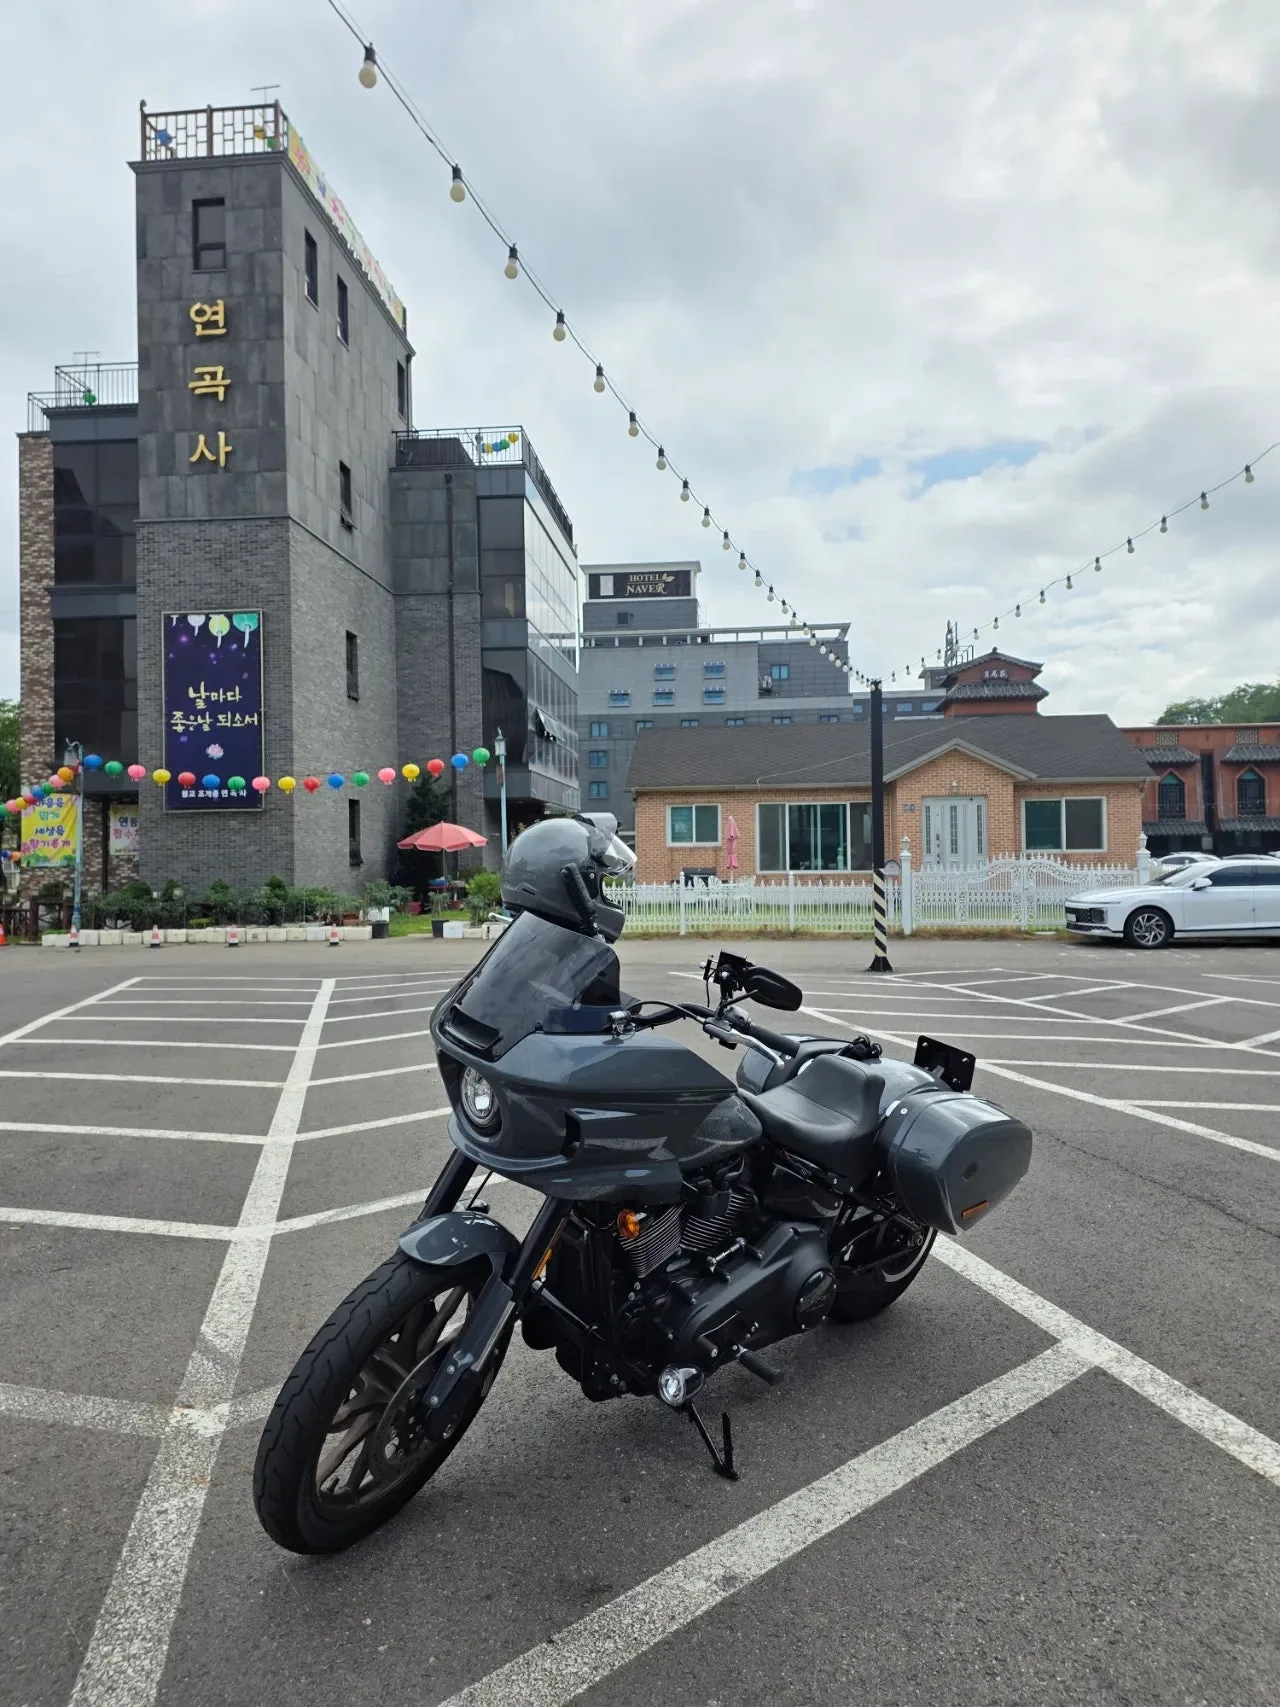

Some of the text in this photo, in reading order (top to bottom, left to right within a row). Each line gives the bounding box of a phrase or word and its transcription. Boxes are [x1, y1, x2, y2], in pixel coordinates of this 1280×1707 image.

[189, 300, 232, 467] 연곡사
[629, 573, 662, 582] HOTEL
[625, 583, 667, 596] NAVER
[188, 681, 243, 709] 날마다
[216, 711, 258, 727] 되소서
[35, 826, 65, 836] 세상을
